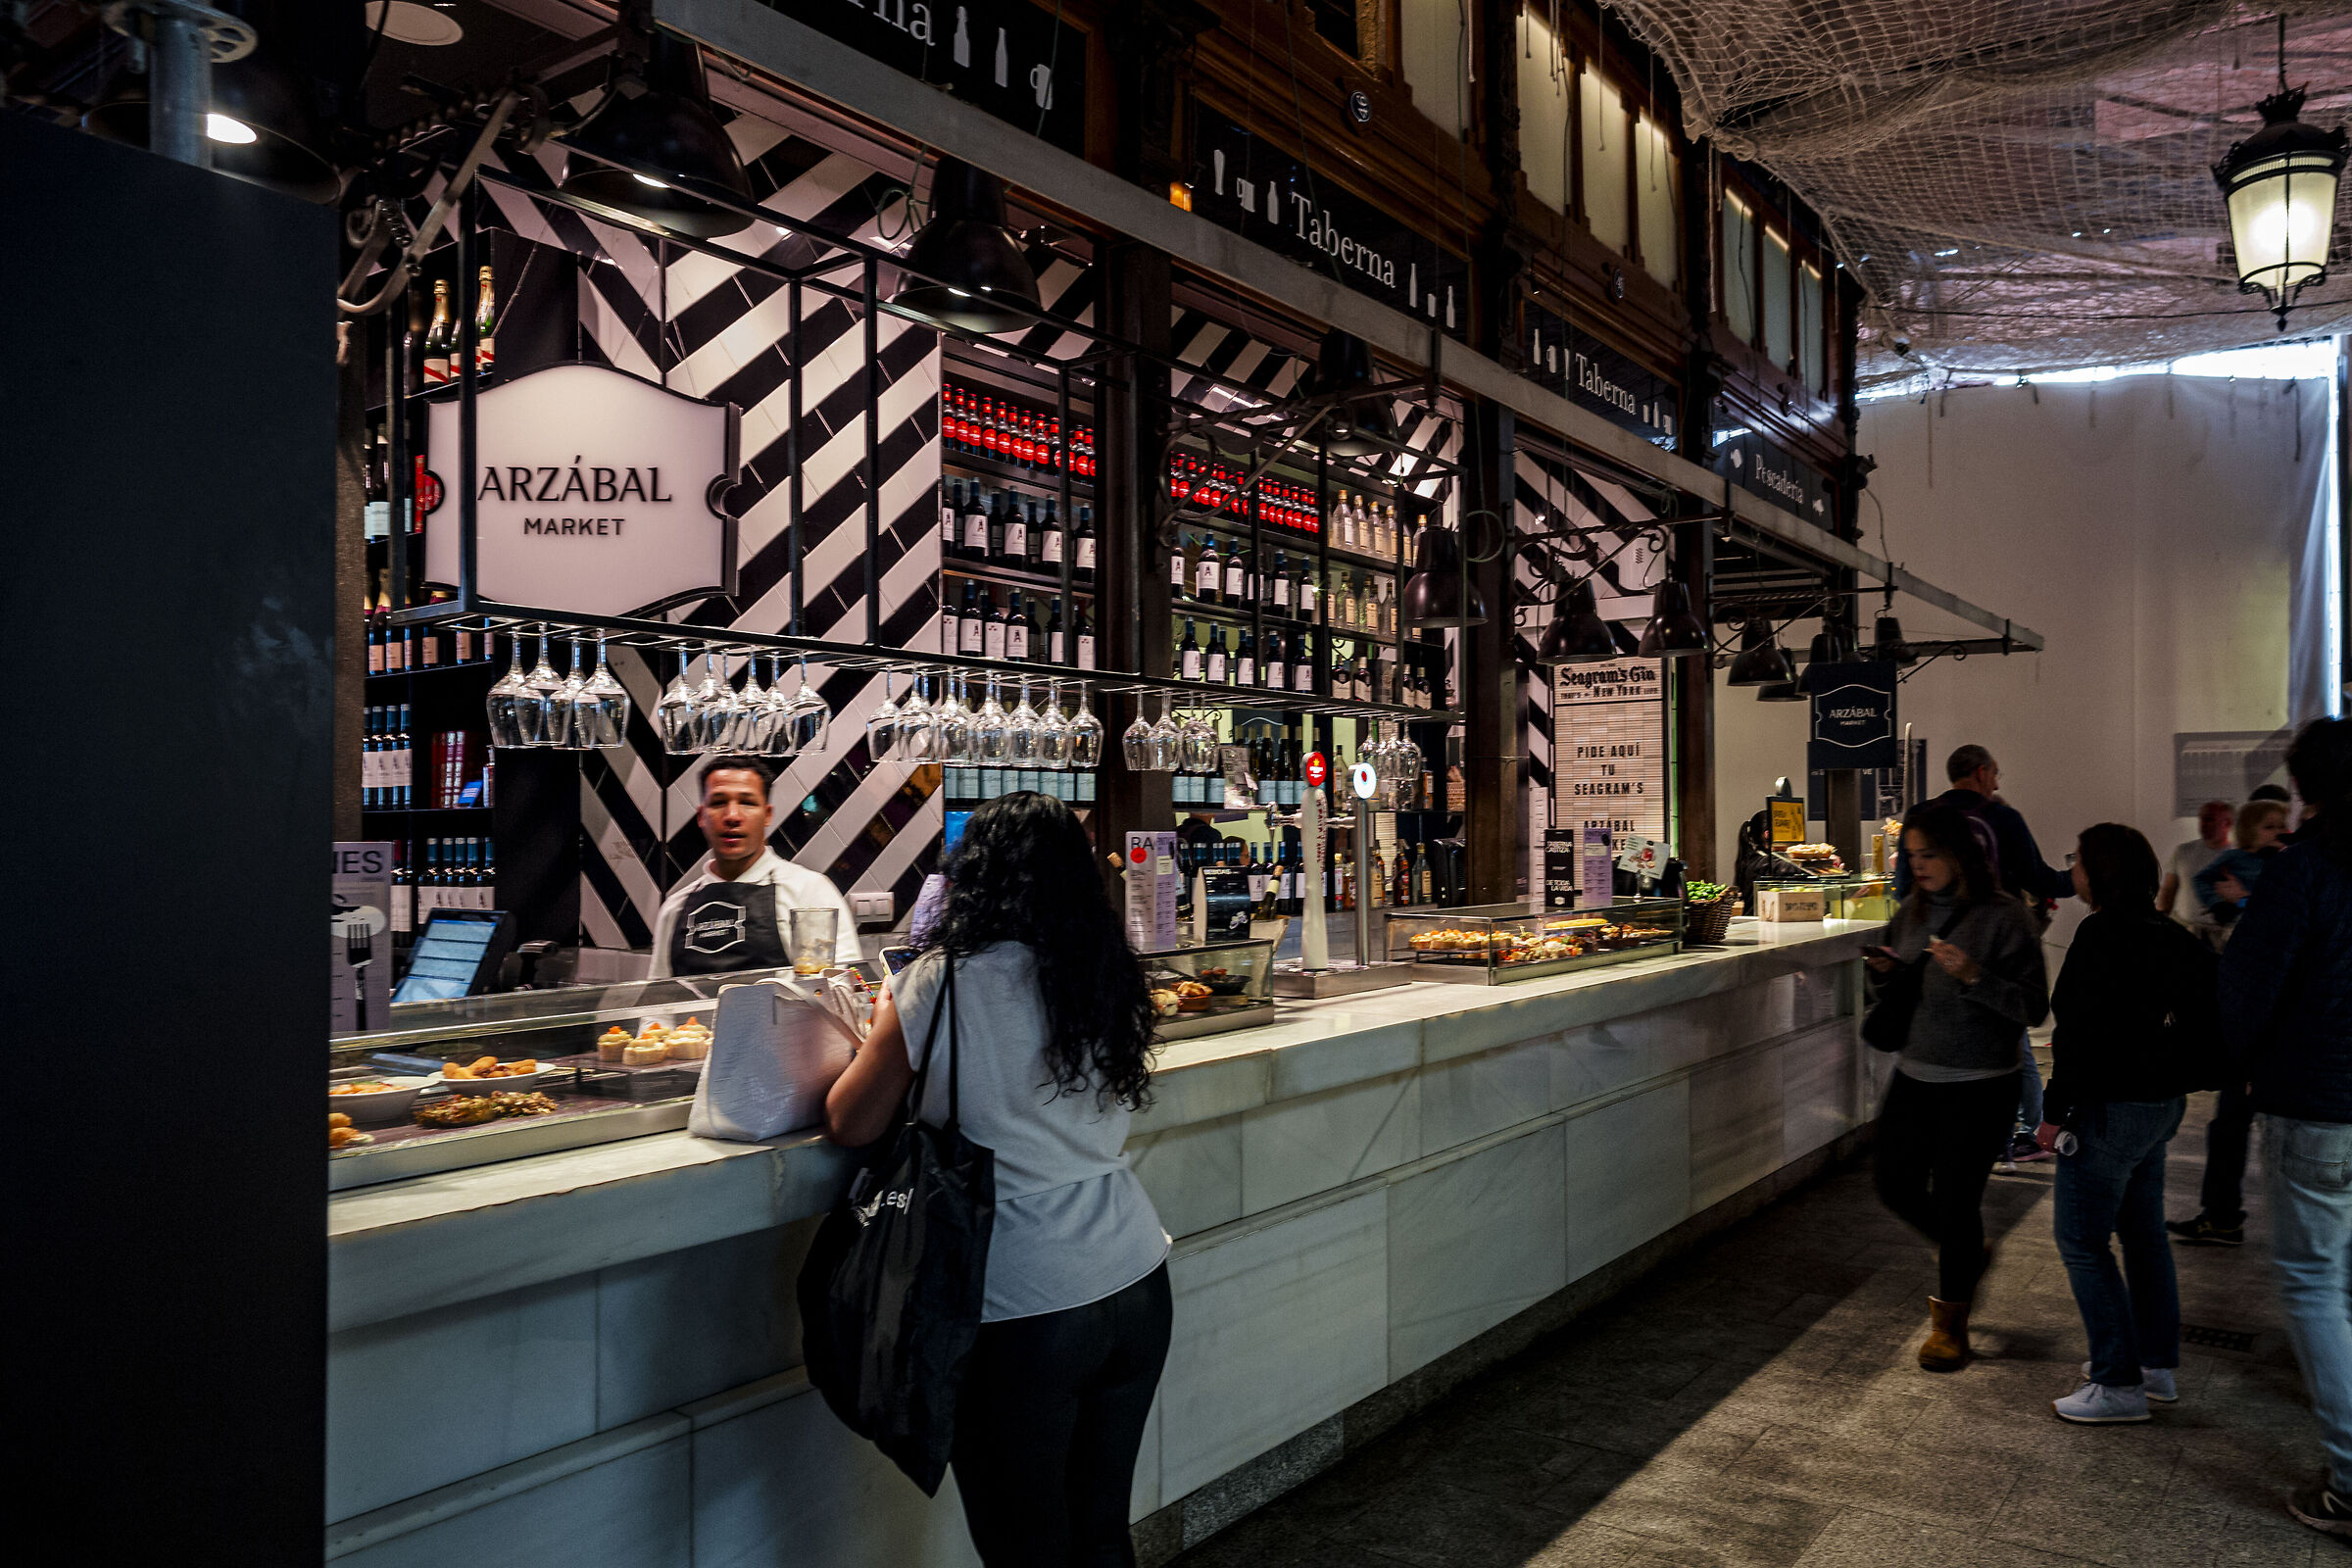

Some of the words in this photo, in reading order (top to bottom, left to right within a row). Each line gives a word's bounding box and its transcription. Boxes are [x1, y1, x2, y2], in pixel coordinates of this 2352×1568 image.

[1291, 191, 1396, 288] Taberna
[1575, 352, 1638, 416] Taberna
[476, 454, 673, 503] ARZÁBAL
[522, 517, 625, 536] MARKET
[1560, 667, 1628, 688] Seagram's
[1630, 666, 1655, 683] Gin
[1829, 706, 1878, 719] ARZÁBAL
[1577, 746, 1604, 759] PIDE
[1610, 742, 1641, 758] AQUÍ
[1600, 764, 1615, 776] TU
[1574, 782, 1643, 796] SEAGRAM'S
